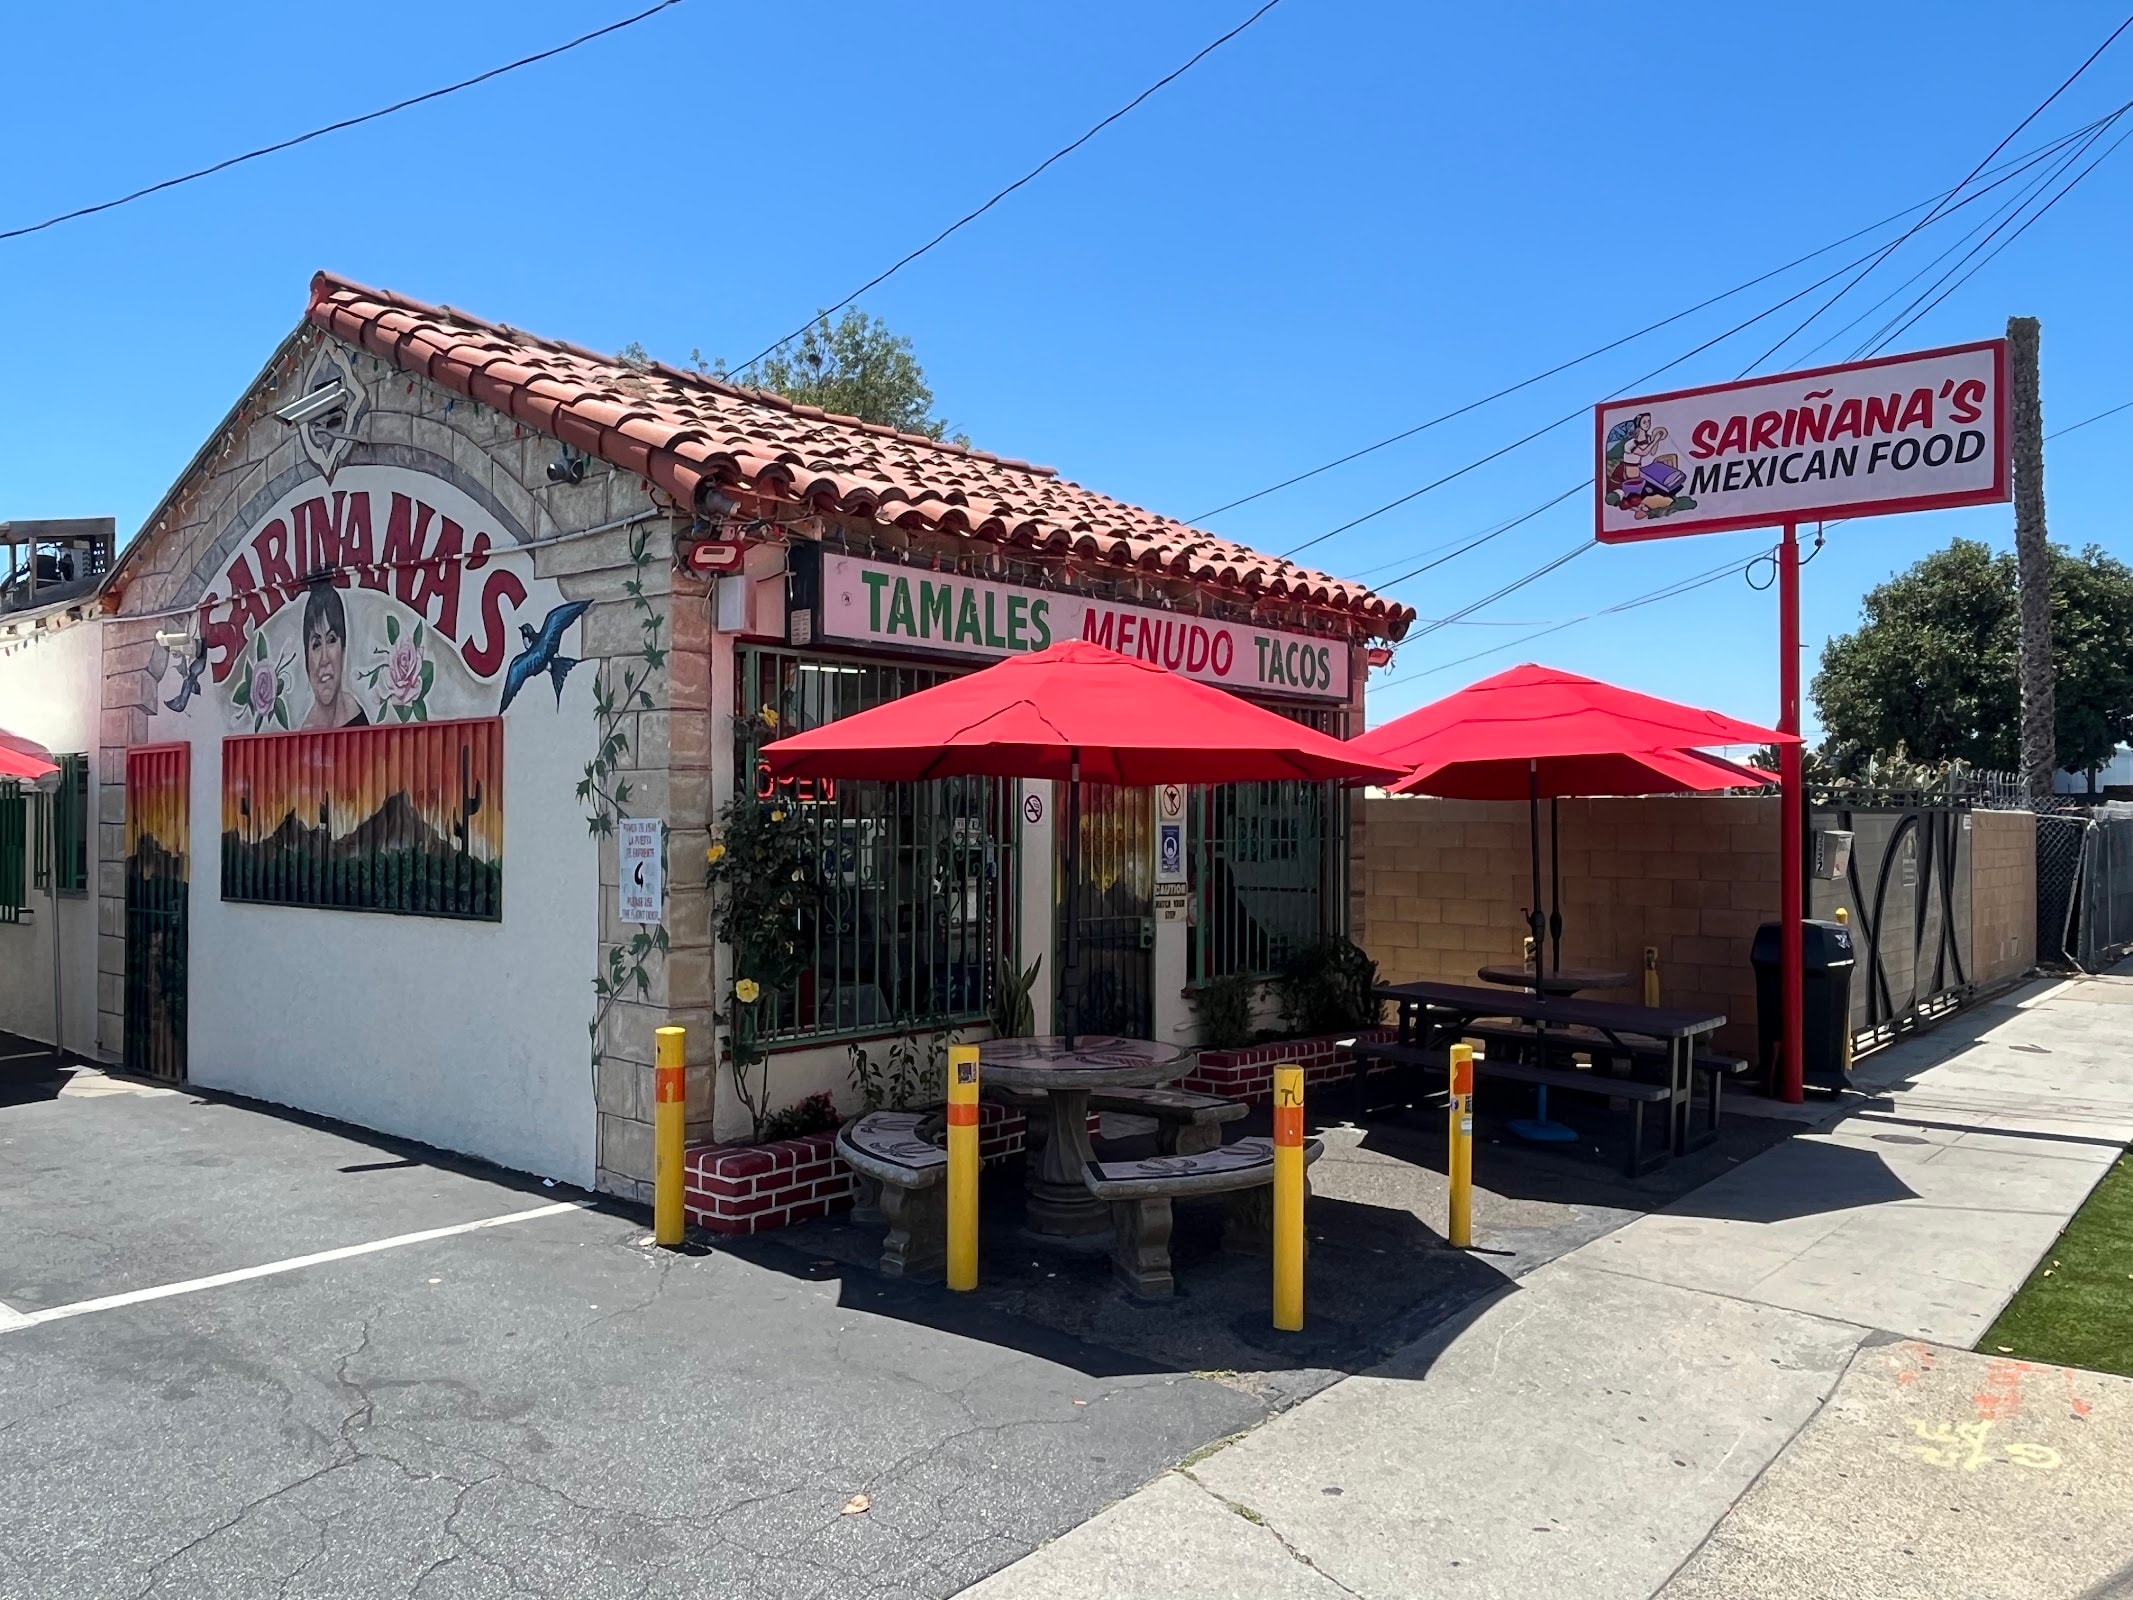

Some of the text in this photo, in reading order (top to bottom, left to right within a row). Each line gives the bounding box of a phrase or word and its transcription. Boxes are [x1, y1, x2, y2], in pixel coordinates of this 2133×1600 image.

[1688, 378, 1987, 460] SARIÑANA'S
[1688, 430, 1987, 496] MEXICAN FOOD
[861, 570, 1052, 652] TAMALES
[1082, 607, 1234, 677] MENUDO
[1253, 636, 1331, 691] TACOS
[753, 763, 835, 799] OEN
[1154, 883, 1186, 896] CAUTION
